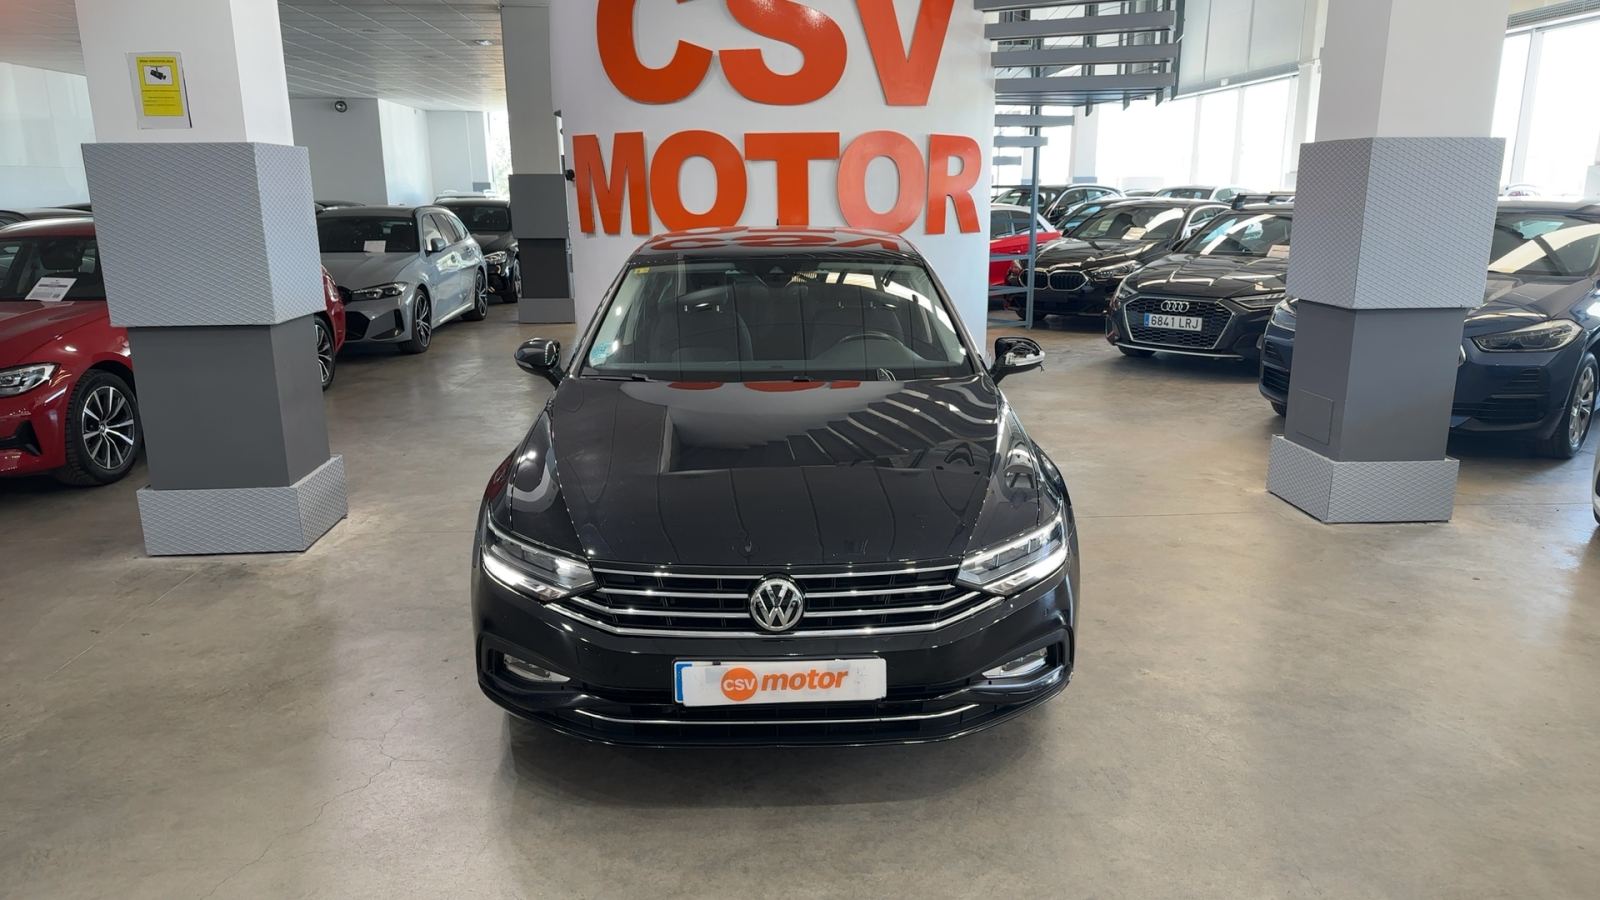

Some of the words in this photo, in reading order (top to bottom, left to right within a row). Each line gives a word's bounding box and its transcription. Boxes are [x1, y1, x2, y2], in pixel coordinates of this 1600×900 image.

[596, 0, 955, 106] CSV
[572, 130, 982, 235] MOTOR
[1151, 315, 1175, 327] 6841
[1178, 317, 1199, 330] LRJ
[760, 669, 849, 691] motor
